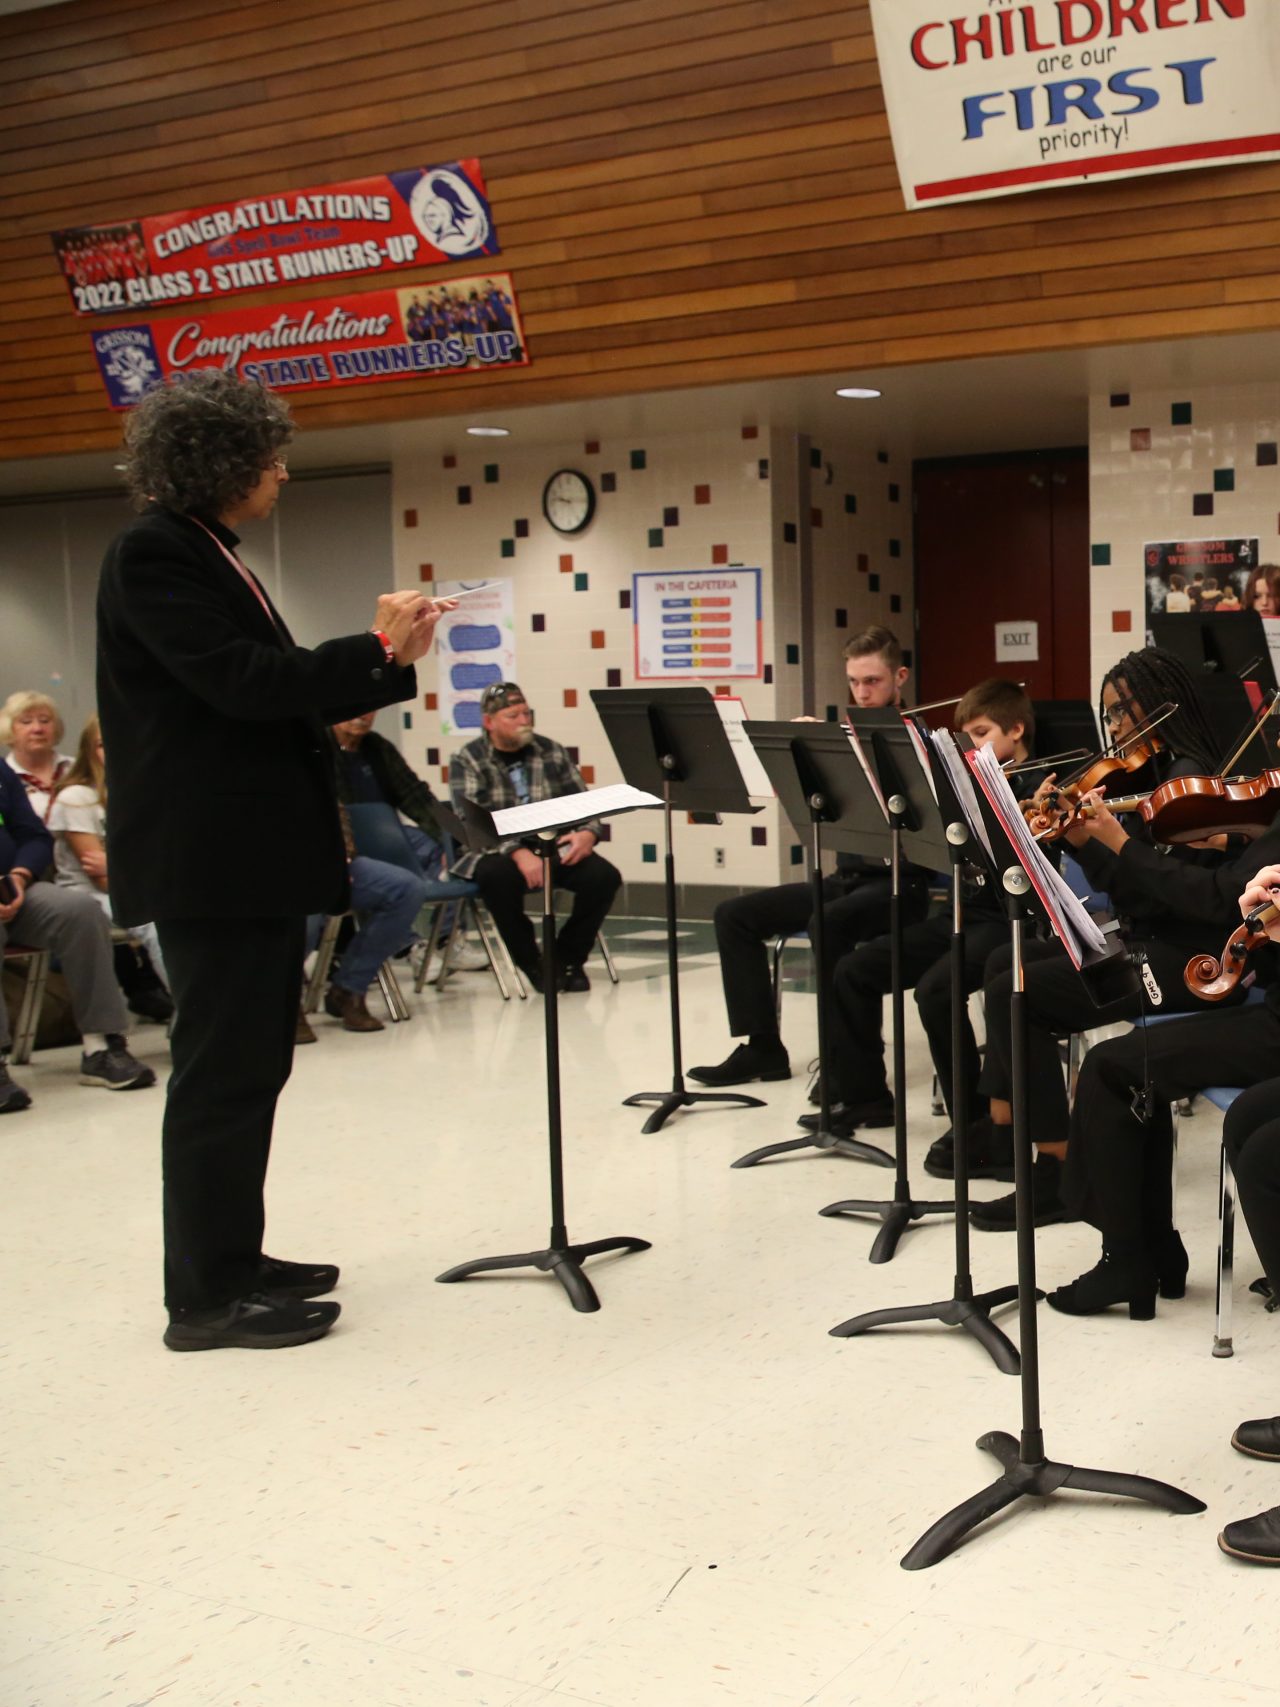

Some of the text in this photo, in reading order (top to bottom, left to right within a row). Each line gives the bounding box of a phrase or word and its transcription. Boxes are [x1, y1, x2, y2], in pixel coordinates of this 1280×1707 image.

[1036, 44, 1117, 74] are our
[962, 57, 1217, 141] FIRST
[1039, 118, 1129, 159] priority!
[153, 194, 391, 259] CONGRATULATIONS
[304, 226, 340, 241] Team
[73, 233, 419, 311] 2022 CLASS 2 STATE RUNNERS-UP
[167, 306, 392, 371] Congratulations
[243, 353, 330, 387] STATE
[333, 331, 517, 381] RUNNERS-UP
[1168, 553, 1234, 564] WRTLERS
[655, 580, 738, 591] IN THE CAFETERIA
[1003, 632, 1032, 646] EXIT
